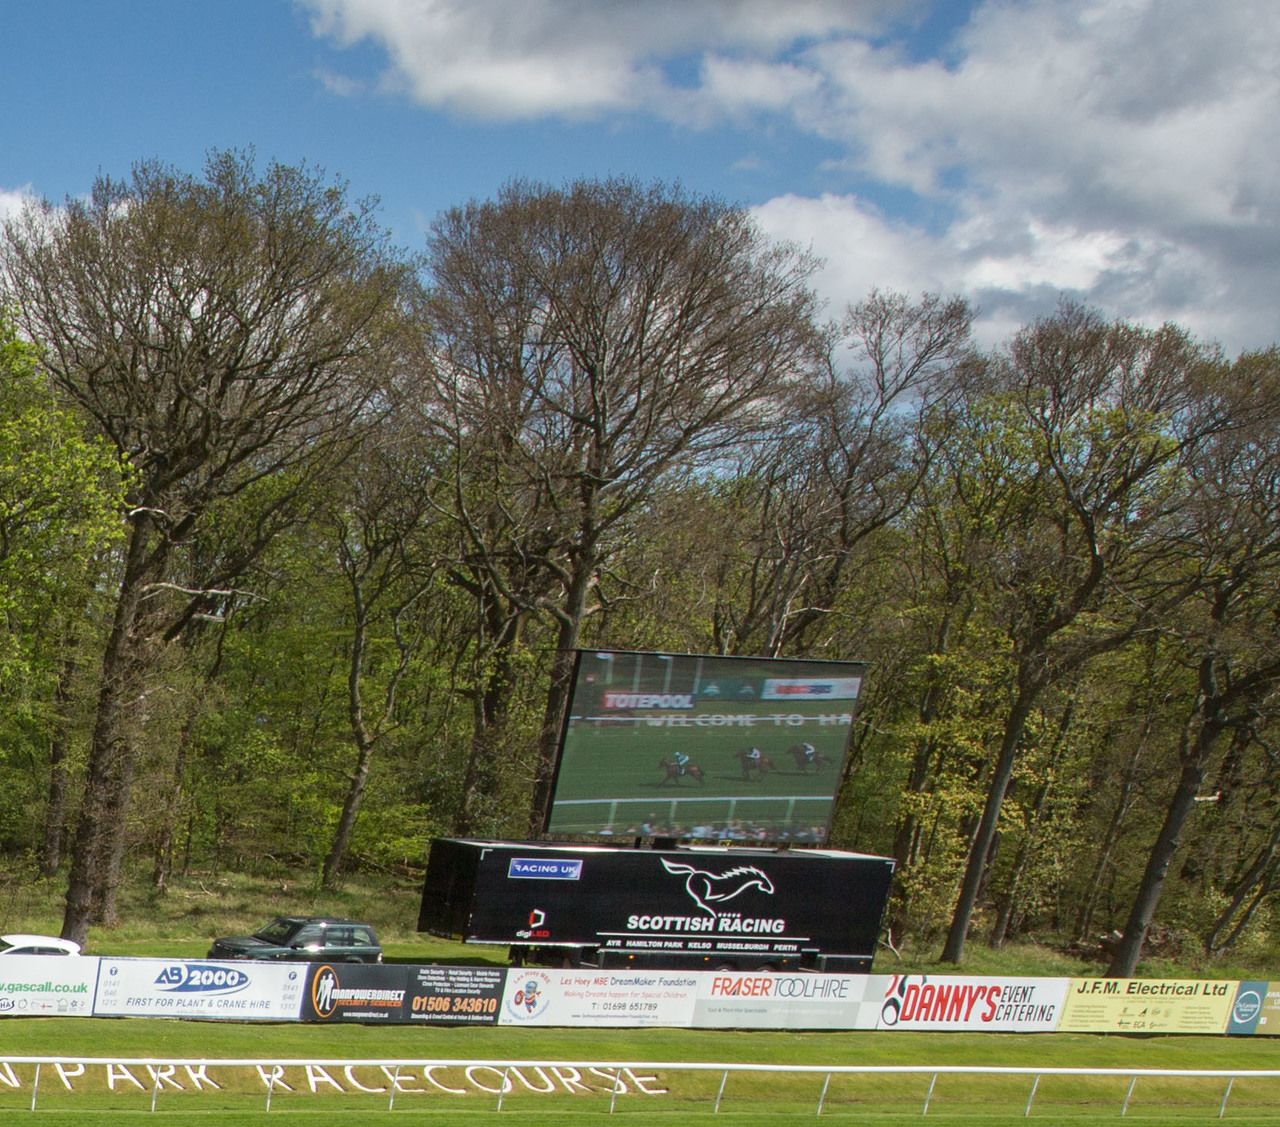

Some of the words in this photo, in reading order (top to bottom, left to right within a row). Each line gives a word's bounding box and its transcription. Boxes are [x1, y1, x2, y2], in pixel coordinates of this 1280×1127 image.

[604, 693, 694, 709] TOTEPOOL
[645, 714, 759, 728] WELCOME
[514, 864, 558, 873] RACING
[561, 865, 576, 874] UK
[627, 915, 715, 932] SCOTTISH
[718, 917, 785, 934] RACING
[606, 939, 621, 947] AYR
[626, 940, 663, 949] HAMILTON
[663, 941, 683, 949] PARK
[687, 941, 712, 950] KELSO
[716, 942, 769, 952] MUSSELBURGH
[773, 944, 798, 953] PERTH
[154, 966, 183, 984] AB
[188, 970, 240, 986] 2000
[560, 976, 572, 985] Les
[574, 977, 591, 987] Hoey
[592, 977, 608, 986] MBE
[610, 977, 656, 987] DreamMaker
[658, 978, 697, 988] Foundation
[711, 977, 773, 997] FRASER
[1000, 985, 1036, 1003] EVENT
[1077, 981, 1121, 995] J.F.M.
[1126, 981, 1199, 996] Electrical
[1202, 983, 1228, 997] Ltd
[126, 997, 152, 1007] FIRST
[155, 998, 174, 1008] FOR
[177, 998, 206, 1008] PLANT
[208, 1000, 213, 1008] &
[216, 999, 246, 1009] CRANE
[250, 1000, 270, 1009] HIRE
[412, 996, 450, 1012] 01506
[452, 997, 497, 1013] 343610
[592, 1003, 599, 1011] T:
[602, 1003, 627, 1011] 01698
[629, 1003, 658, 1011] 651789
[899, 984, 1002, 1022] DANNY'S
[996, 1004, 1055, 1022] CATERING
[53, 1059, 222, 1091] PARK
[255, 1063, 669, 1095] RACECOURSE
